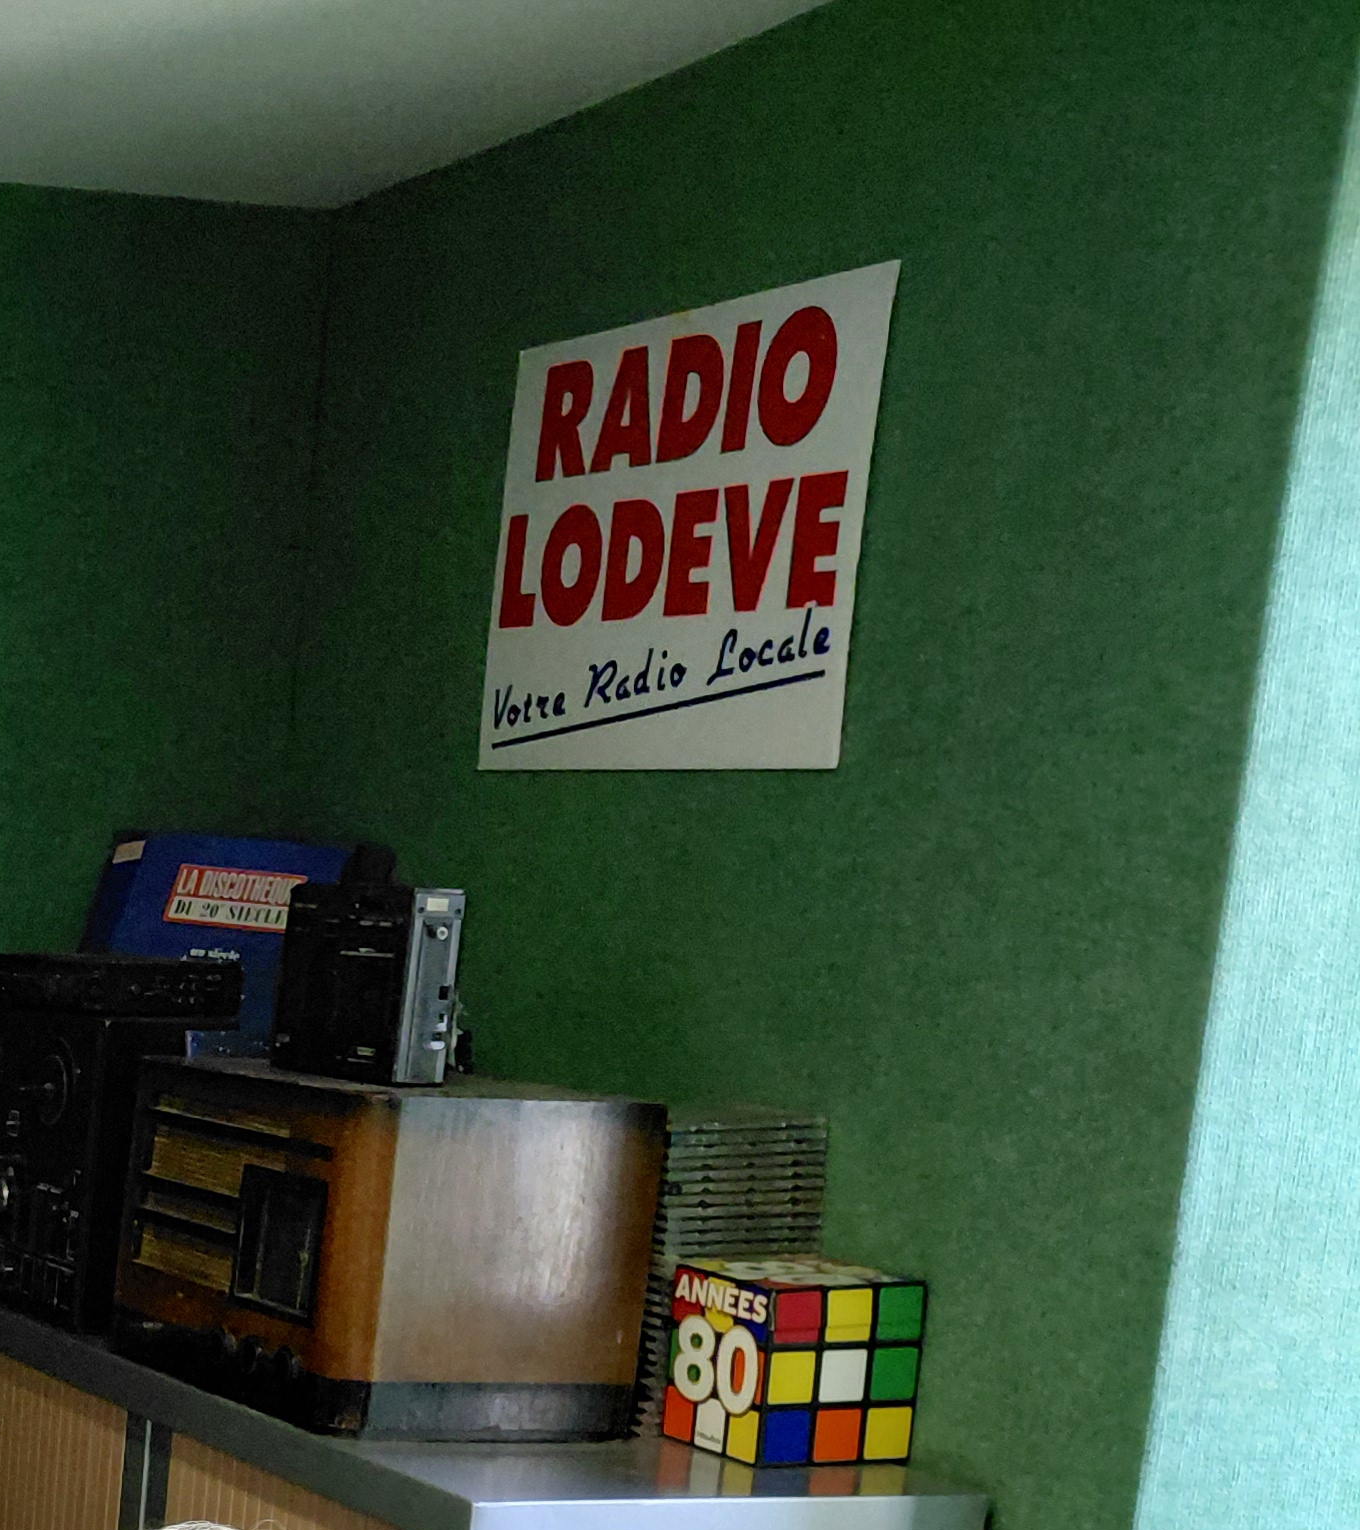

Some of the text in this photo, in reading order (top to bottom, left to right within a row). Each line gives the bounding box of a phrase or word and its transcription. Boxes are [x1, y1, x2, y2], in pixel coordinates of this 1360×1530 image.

[534, 305, 838, 482] RADIO
[498, 469, 849, 629] LODEVE
[493, 607, 831, 730] Votre Radio Locale
[176, 868, 199, 896] LA
[673, 1313, 759, 1418] 80
